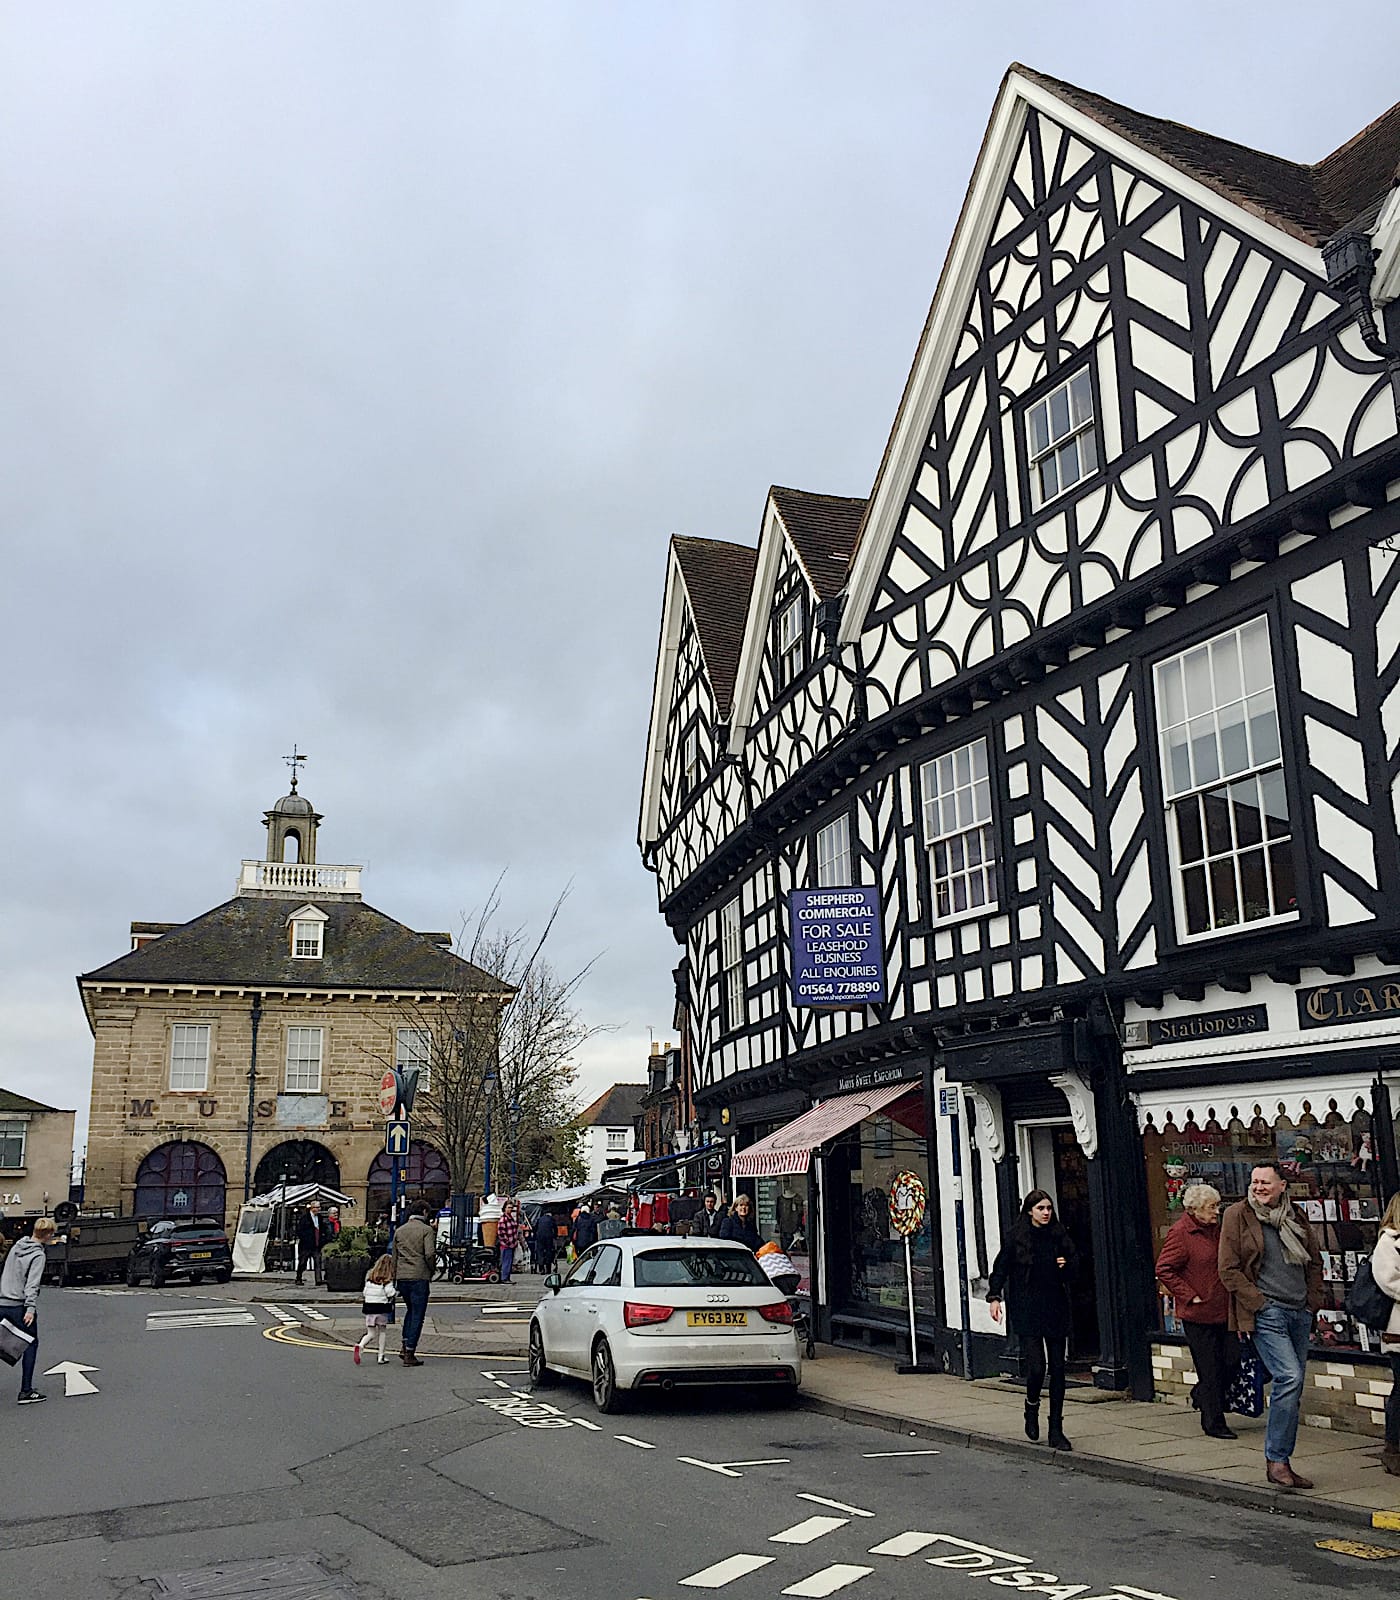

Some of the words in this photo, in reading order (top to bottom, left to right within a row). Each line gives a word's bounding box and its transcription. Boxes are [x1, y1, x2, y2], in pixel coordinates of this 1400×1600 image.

[806, 893, 865, 907] SHEPHERD
[798, 905, 875, 921] COMMERCIAL
[801, 924, 832, 939] FOR
[836, 922, 872, 938] SALE
[806, 939, 869, 953] LEASEHOLD
[814, 952, 862, 965] BUSINESS
[800, 967, 821, 979] ALL
[823, 965, 878, 979] ENQUIRIES
[798, 983, 834, 996] 01564
[836, 981, 881, 994] 778890
[1160, 1014, 1256, 1039] Stationers
[0, 1193, 22, 1204] TA
[693, 1312, 722, 1324] FY63
[725, 1312, 746, 1324] BXZ
[925, 1552, 1136, 1600] DISA
